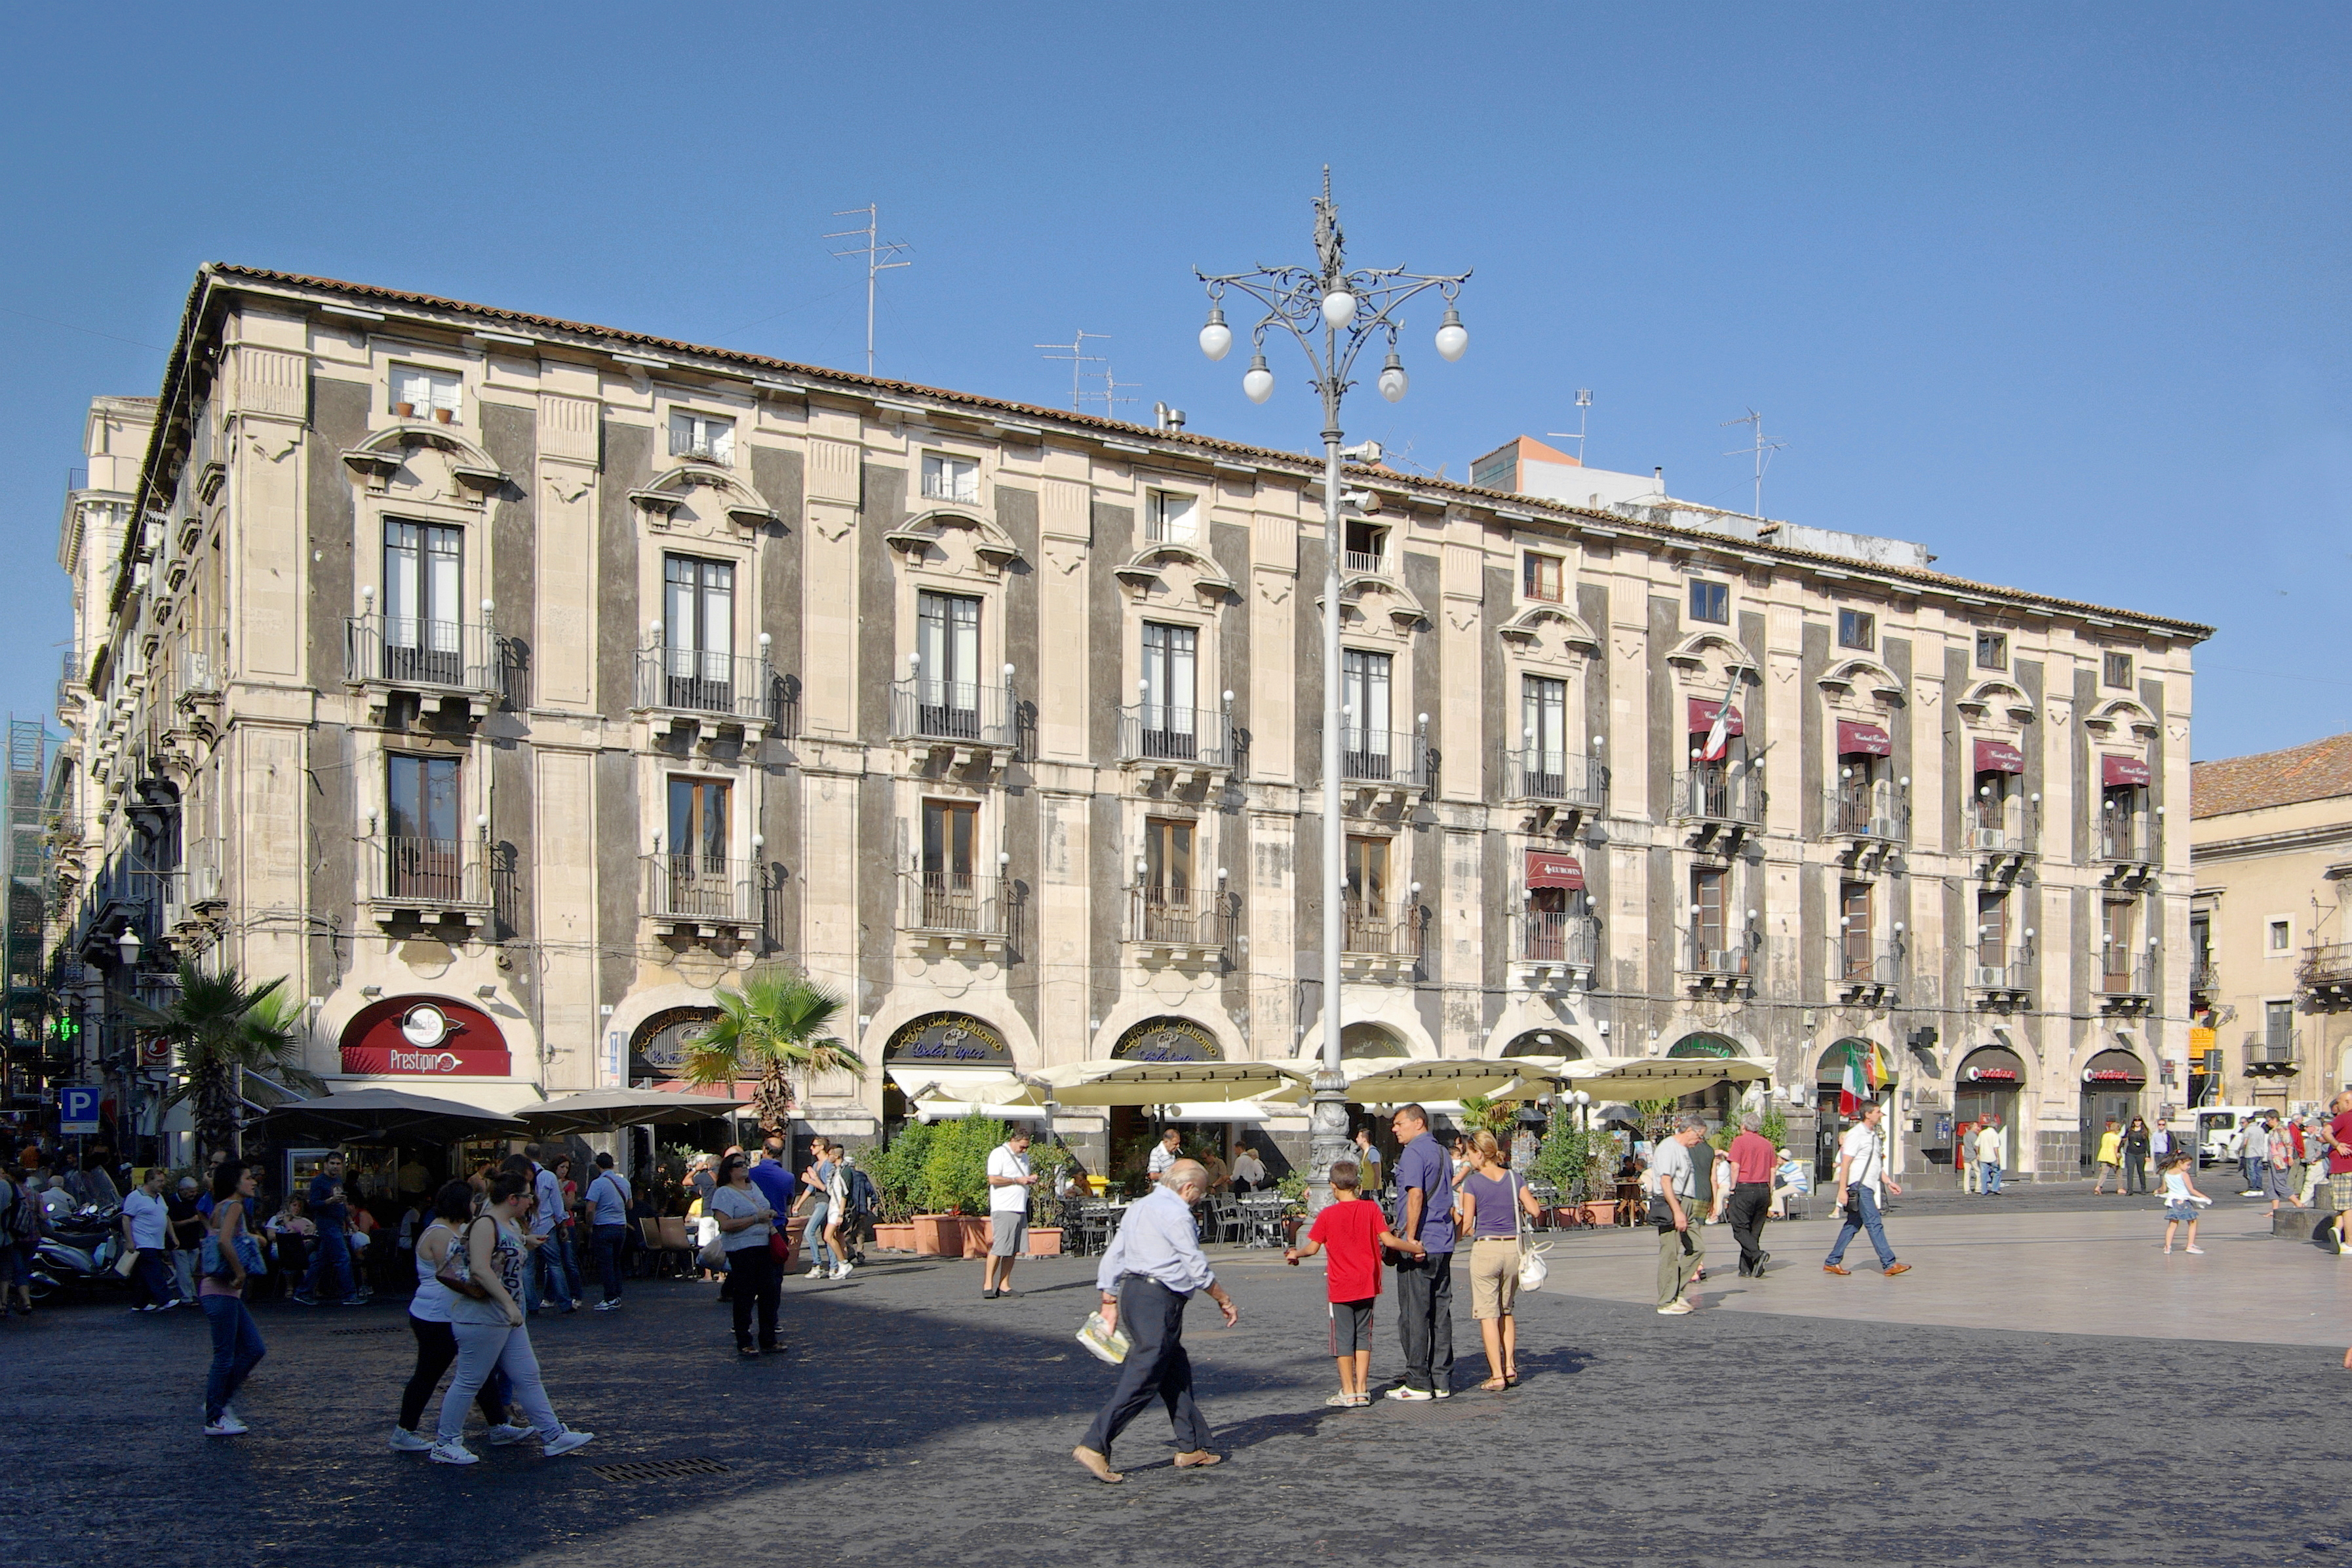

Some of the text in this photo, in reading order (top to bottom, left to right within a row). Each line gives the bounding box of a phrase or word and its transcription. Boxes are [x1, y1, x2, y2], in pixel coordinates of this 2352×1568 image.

[1552, 866, 1581, 876] EUROFIN
[630, 1010, 702, 1053] Tabaccheria
[928, 1011, 951, 1028] del
[956, 1015, 1004, 1052] Duomo
[1147, 1018, 1168, 1034] del
[1175, 1020, 1219, 1057] Duomo
[69, 1091, 91, 1118] P
